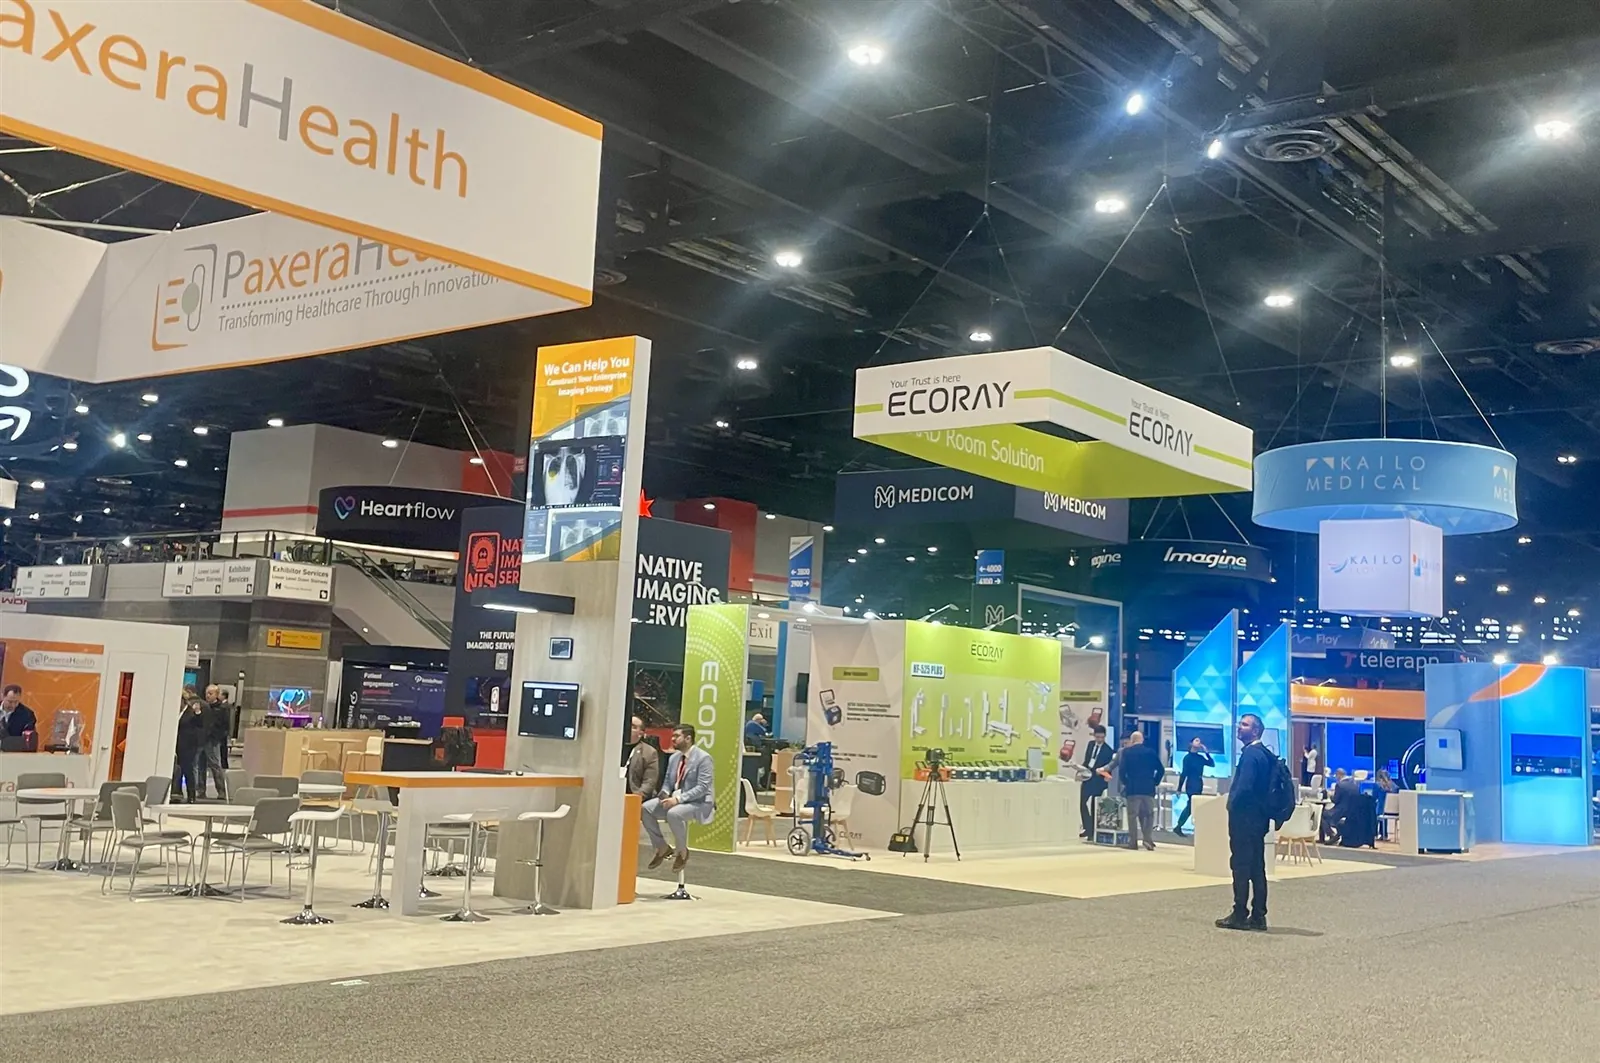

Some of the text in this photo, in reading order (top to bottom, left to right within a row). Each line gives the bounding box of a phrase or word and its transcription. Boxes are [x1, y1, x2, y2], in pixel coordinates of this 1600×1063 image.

[217, 308, 293, 332] Transforming
[295, 297, 362, 323] Healthcare
[364, 277, 420, 308] Through
[543, 356, 630, 376] We Can Help You
[890, 374, 961, 389] Your Trust is here
[888, 381, 1011, 417] ECORAY
[1129, 411, 1193, 457] ECORAY
[946, 429, 987, 458] Room
[991, 440, 1044, 473] Solution
[1340, 456, 1426, 471] KAILO
[1305, 475, 1421, 492] MEDICAL
[898, 485, 973, 504] MEDICOM
[360, 500, 455, 520] Heartflow
[1060, 496, 1106, 520] MEDICOM
[1163, 546, 1247, 568] Imagine
[1350, 554, 1402, 565] KAILO
[272, 565, 329, 578] Exhibitor Services
[638, 553, 703, 582] NATIVE
[636, 577, 720, 606] IMAGING
[479, 631, 493, 640] THE
[749, 622, 773, 639] Exit
[466, 641, 494, 650] IMAGING
[970, 643, 1005, 659] ECORAY
[1320, 695, 1335, 708] for
[1337, 696, 1354, 709] All
